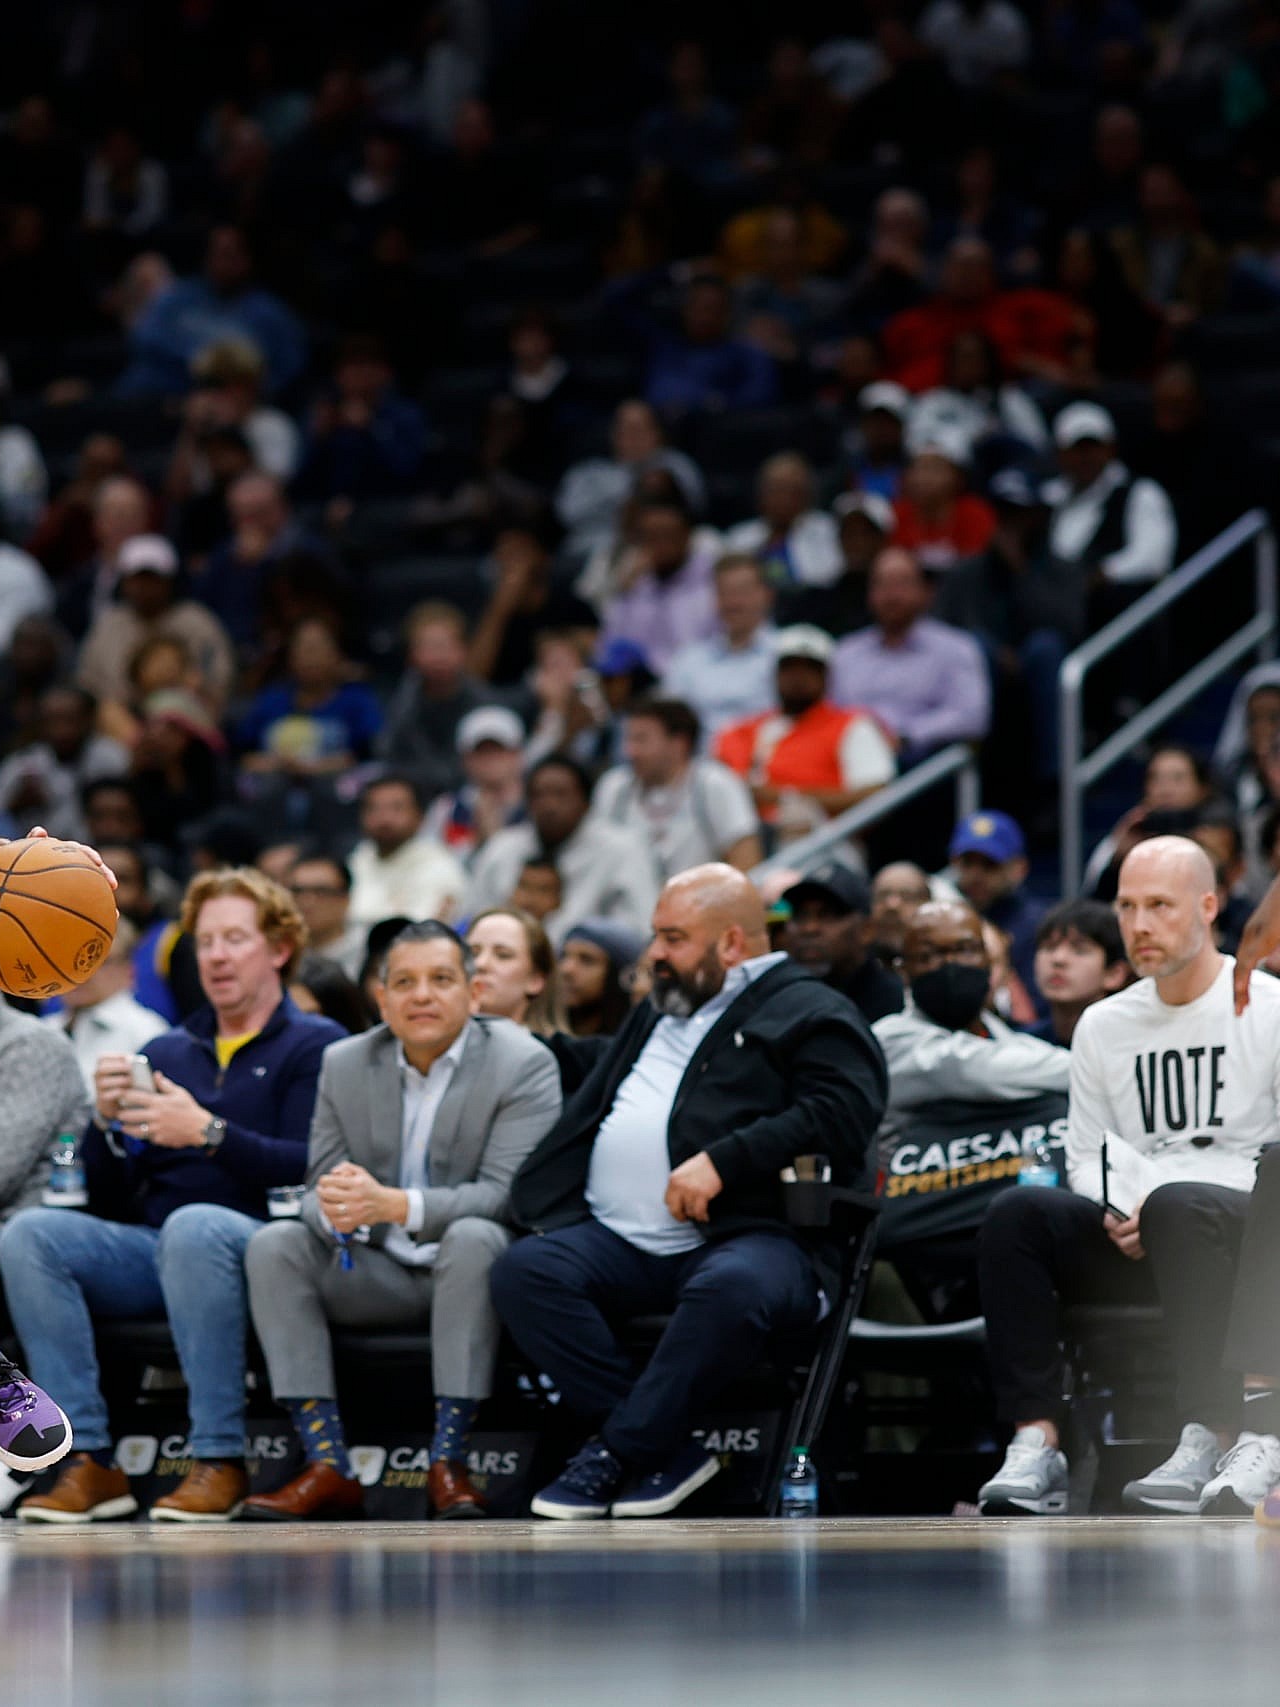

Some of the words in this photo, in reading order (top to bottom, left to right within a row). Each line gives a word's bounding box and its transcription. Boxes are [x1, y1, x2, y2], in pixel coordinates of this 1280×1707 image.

[1136, 1046, 1226, 1134] VOTE
[890, 1117, 1069, 1175] CAESARS
[886, 1157, 1026, 1199] SPORTSBOO
